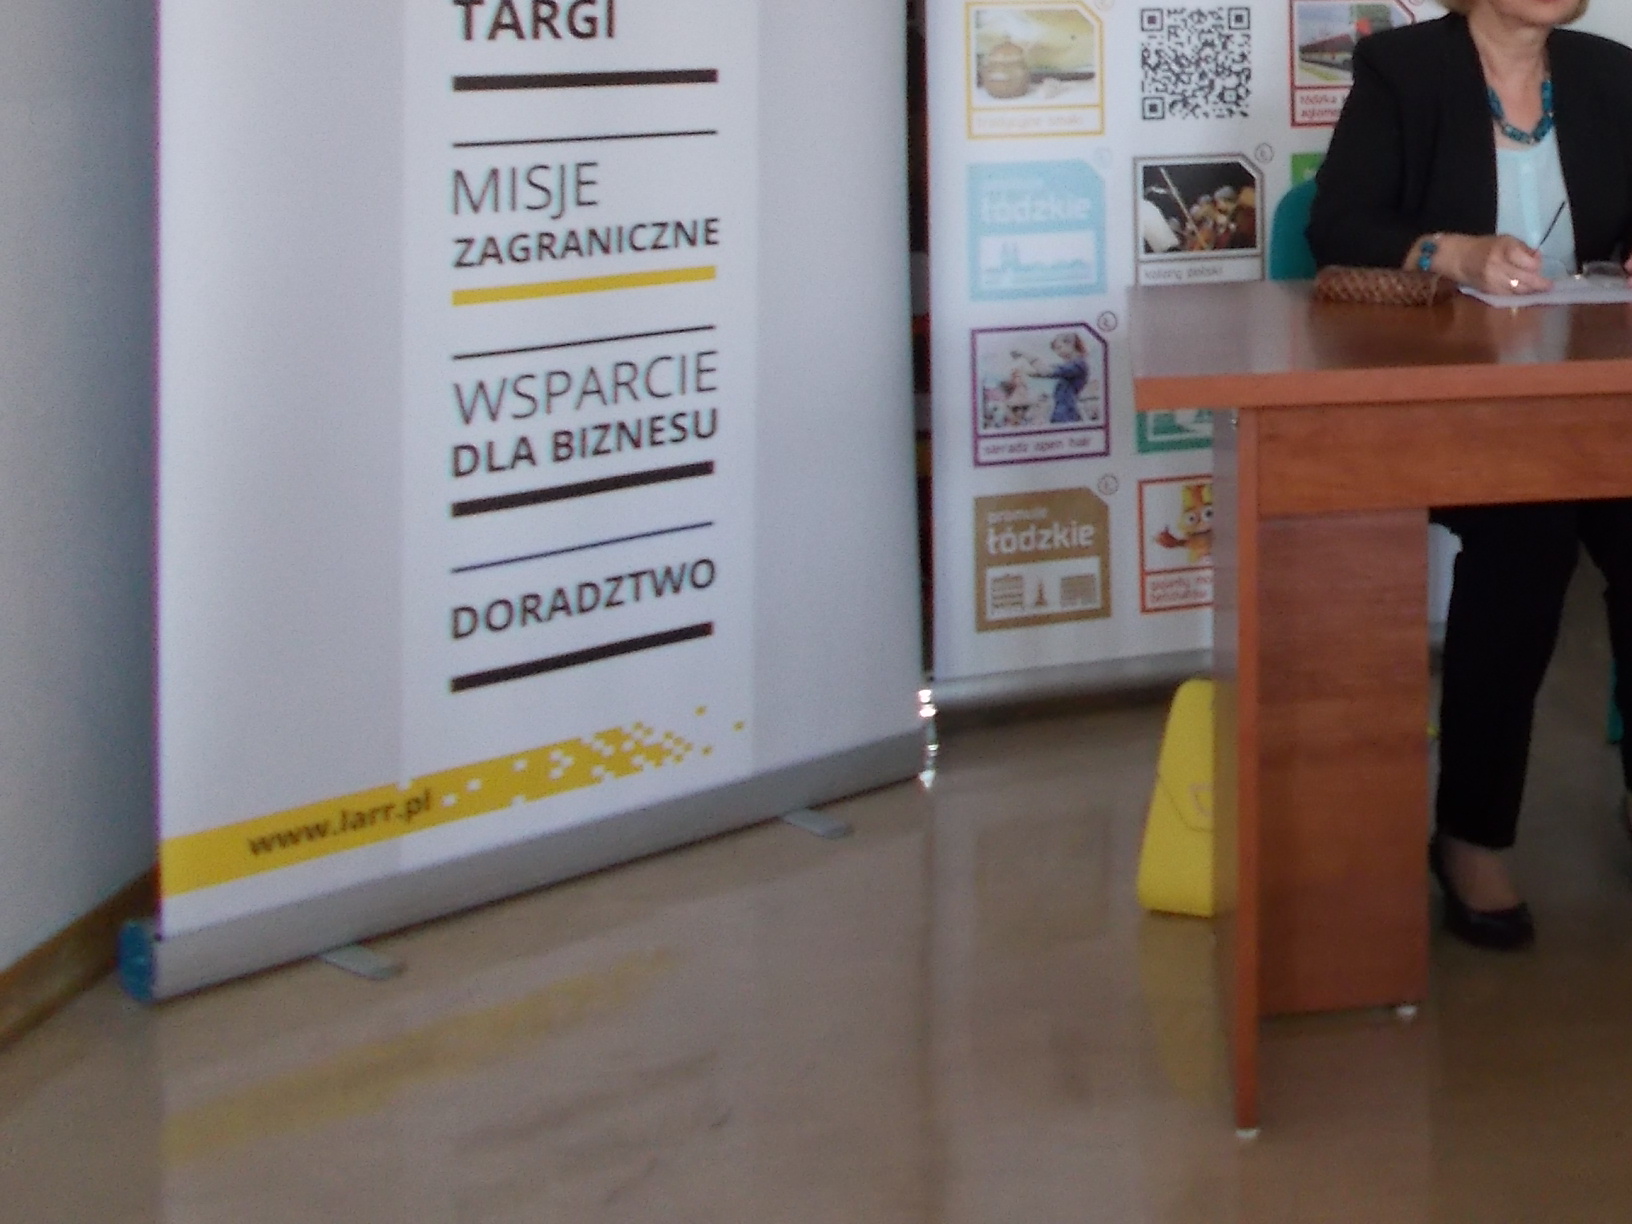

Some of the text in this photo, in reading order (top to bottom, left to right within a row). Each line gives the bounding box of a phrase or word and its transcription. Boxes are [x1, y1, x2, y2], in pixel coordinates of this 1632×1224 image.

[452, 161, 599, 219] MISJE
[453, 218, 720, 268] ZAGRANICZNE
[453, 351, 718, 426] WSPARCIE
[452, 408, 718, 478] DLA BIZNESU
[452, 559, 716, 639] DORADZTWO
[247, 790, 432, 858] www.larr.pl
